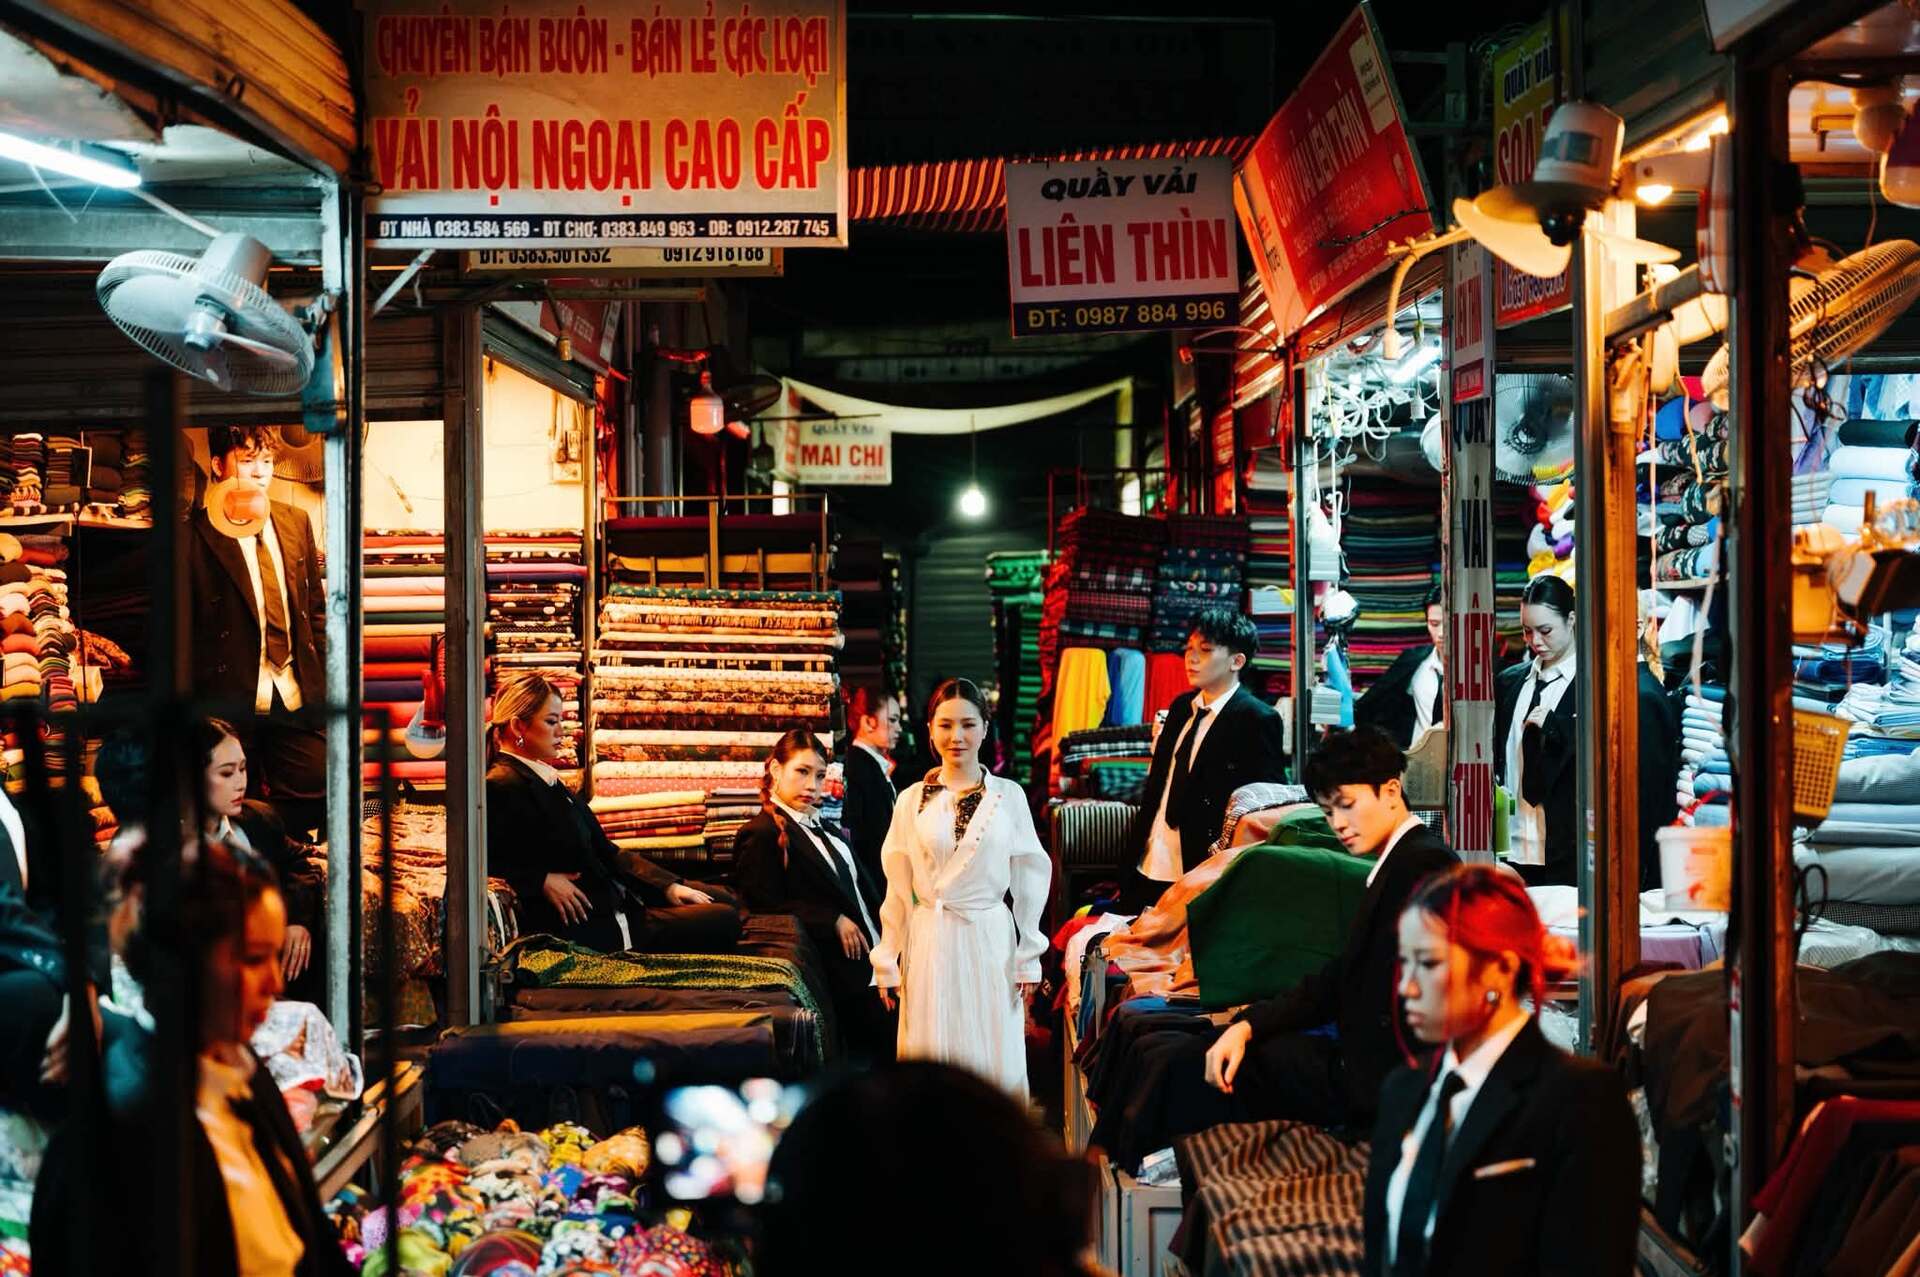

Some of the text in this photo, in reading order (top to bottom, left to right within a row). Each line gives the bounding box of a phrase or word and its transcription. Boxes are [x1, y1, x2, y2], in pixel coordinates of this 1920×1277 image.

[377, 5, 472, 78] CHUYÊN
[479, 5, 531, 78] BÁN
[539, 5, 608, 74] BUÔN
[631, 5, 682, 79] BÁN
[690, 1, 717, 73] LẺ
[724, 4, 767, 78] CÁC
[773, 16, 828, 86] LOẠI
[375, 88, 830, 206] VẢI NỘI NGOẠI CAO CẤP
[1041, 166, 1198, 202] QUẦY VẢI
[400, 217, 432, 237] NHÀ
[434, 220, 500, 237] 0383.584
[503, 220, 530, 237] 569
[600, 220, 666, 237] 0383.849
[669, 220, 695, 236] 963
[735, 219, 799, 236] 0912.287
[803, 219, 829, 236] 745
[1018, 212, 1115, 287] LIÊN
[1127, 207, 1229, 282] THÌN
[1028, 301, 1226, 328] ĐT: 0987 884 996
[801, 444, 884, 466] MAI CHI
[1462, 473, 1487, 568] VẢI
